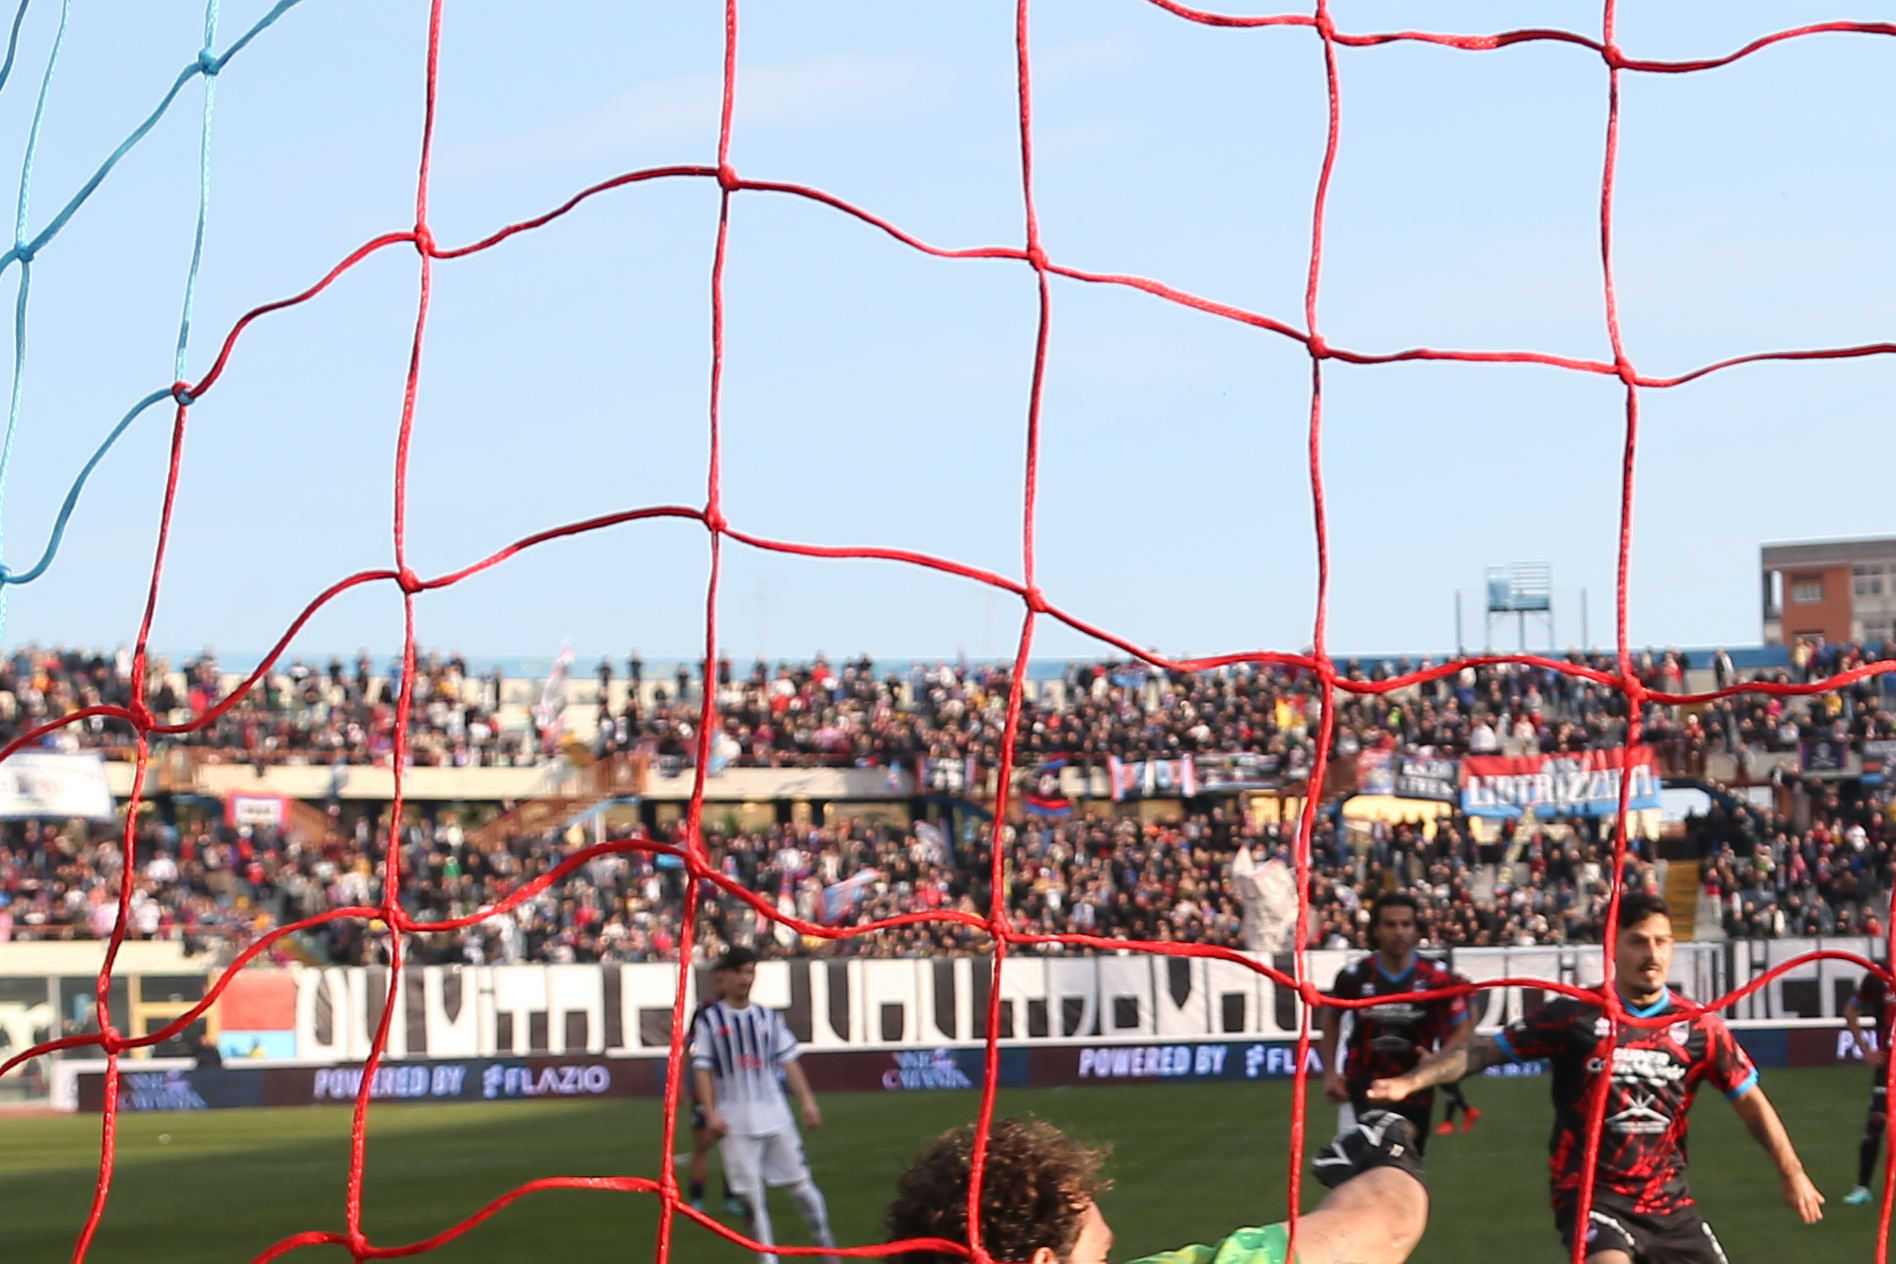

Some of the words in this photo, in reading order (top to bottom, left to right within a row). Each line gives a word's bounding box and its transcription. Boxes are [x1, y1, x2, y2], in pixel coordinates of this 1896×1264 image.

[1079, 1046, 1191, 1077] POWERED
[1195, 1045, 1228, 1075] BY
[431, 1063, 467, 1096] BY
[505, 1065, 611, 1096] FLAZIO
